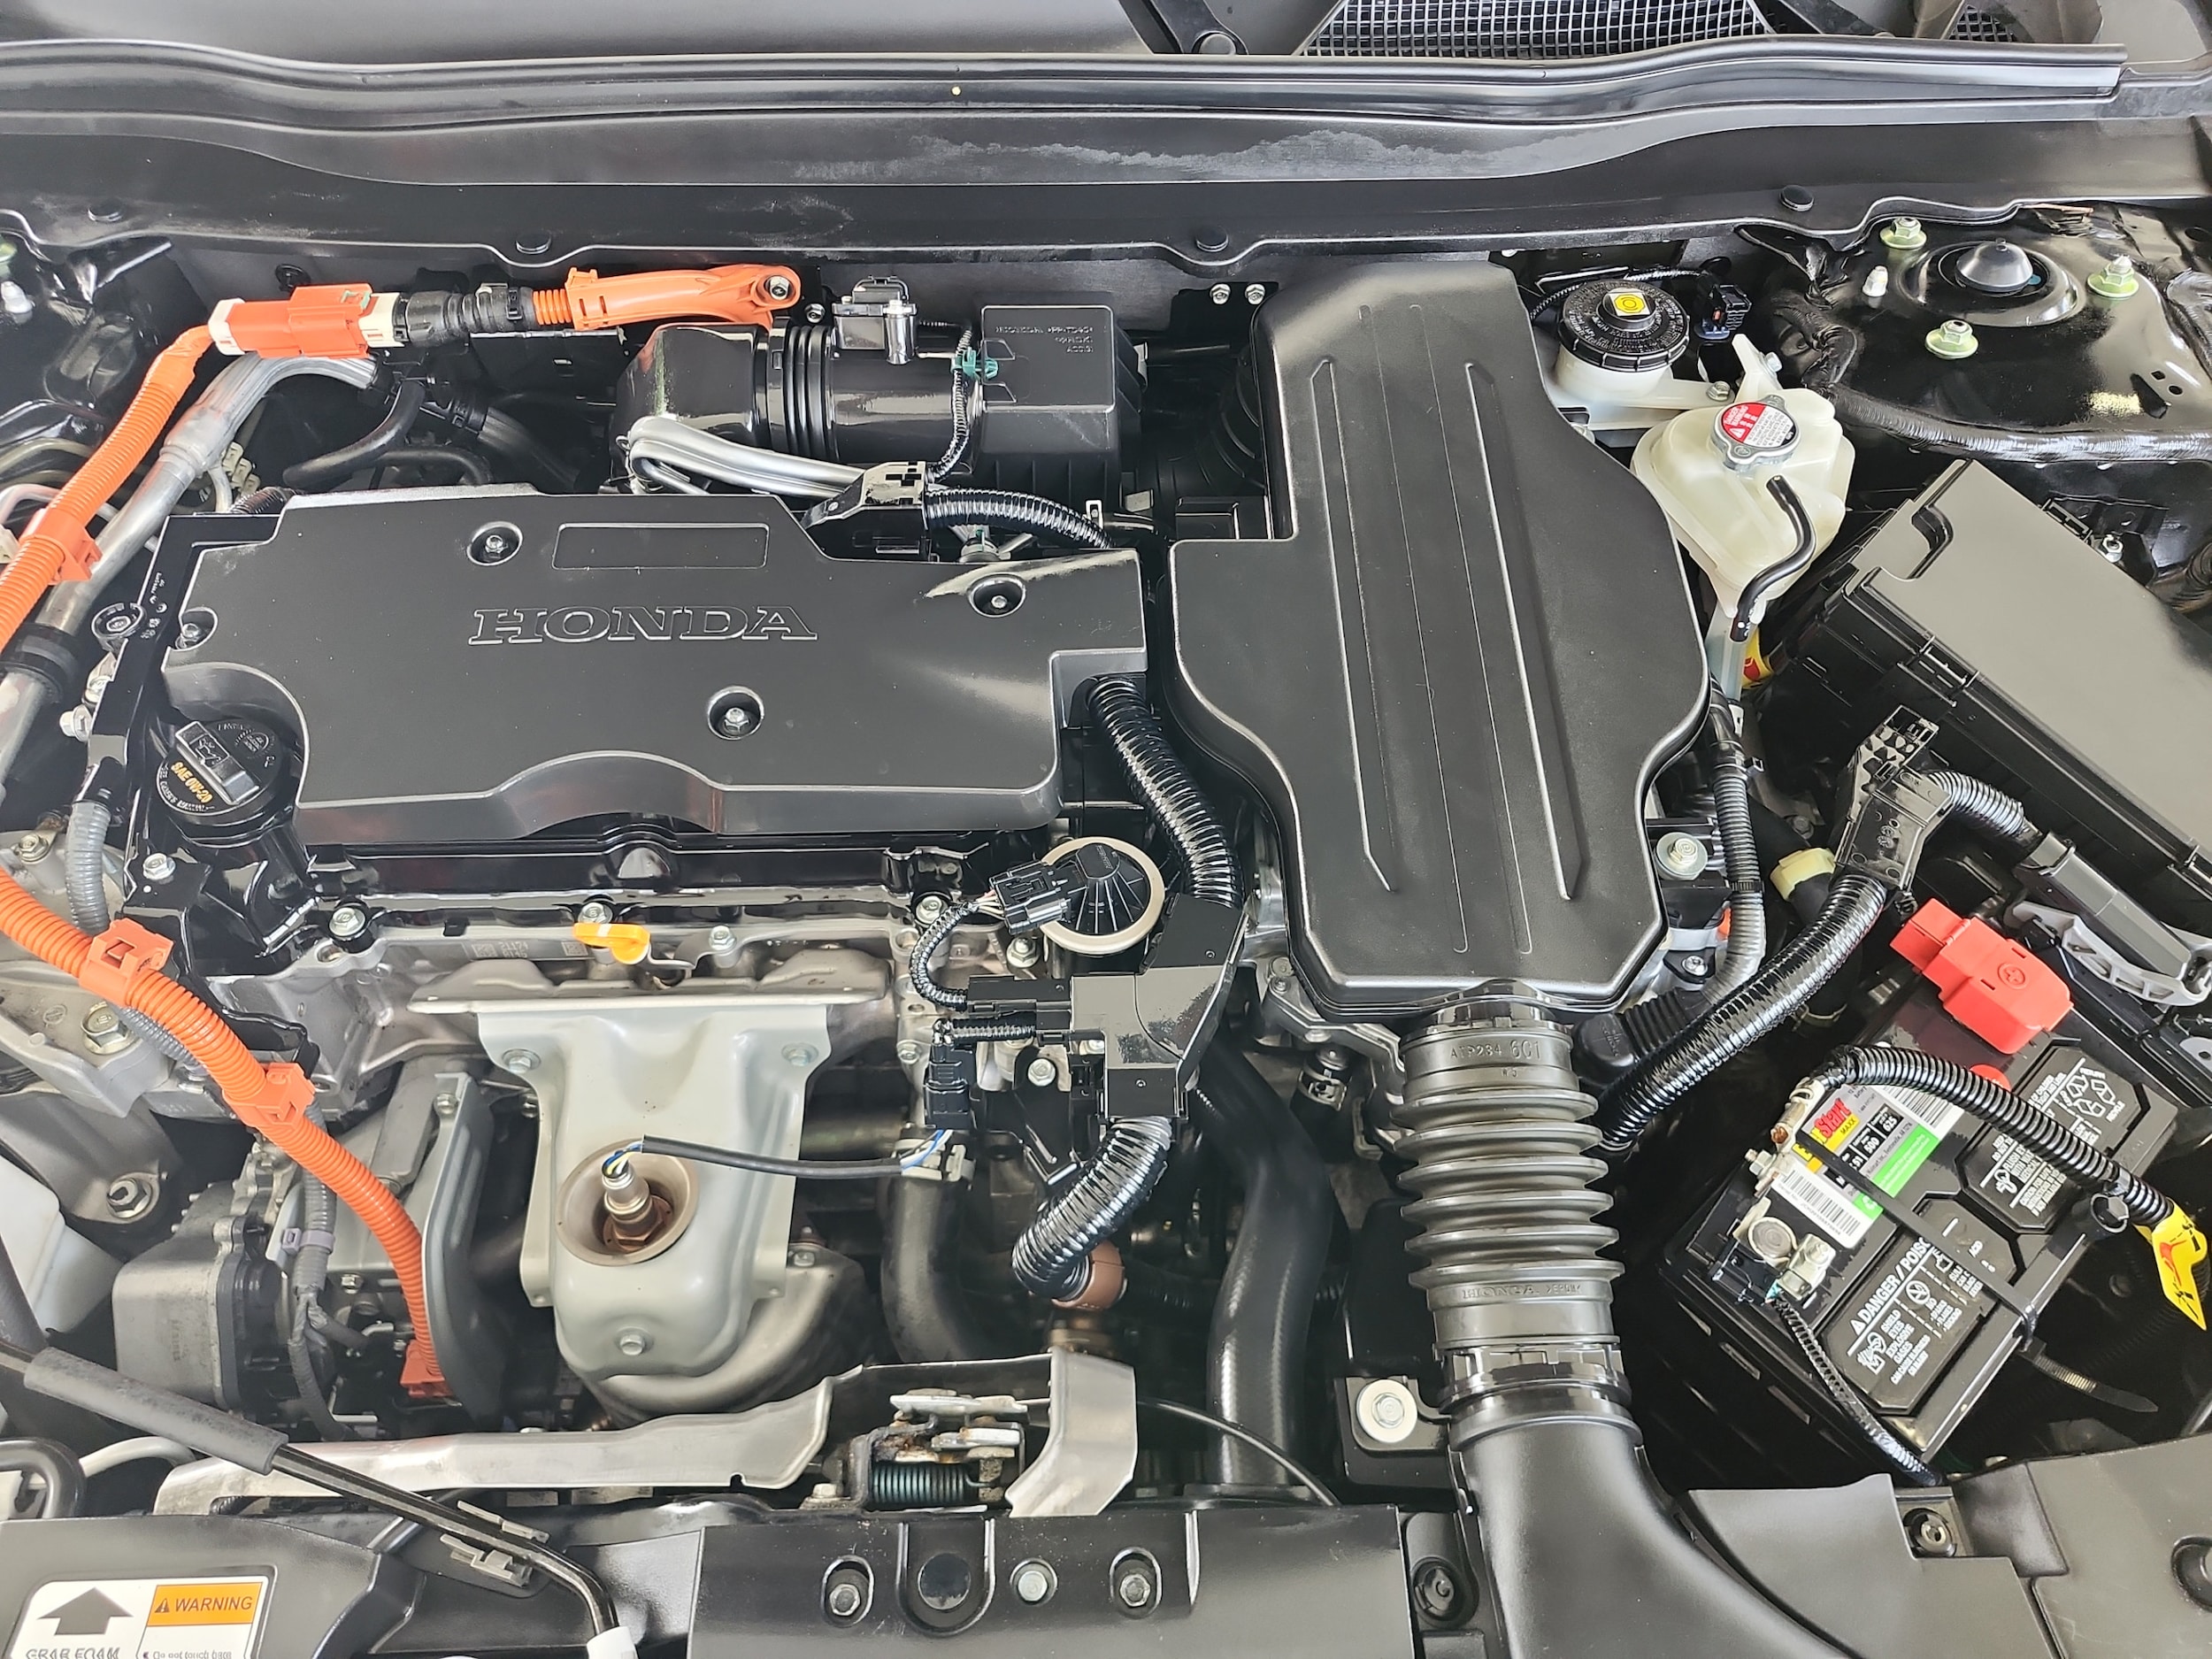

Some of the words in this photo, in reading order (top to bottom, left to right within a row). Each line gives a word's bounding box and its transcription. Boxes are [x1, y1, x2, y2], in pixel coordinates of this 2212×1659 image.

[468, 605, 818, 646] HONDA
[171, 762, 193, 781] SAE
[185, 777, 212, 803] 0W-20
[1840, 1117, 1856, 1135] MAXX
[1881, 1115, 1897, 1132] 625
[1863, 1136, 1879, 1153] 500
[2002, 1151, 2020, 1171] FLUSH
[2017, 1159, 2039, 1182] MEDICAL
[1924, 1298, 1937, 1310] NO
[1880, 1310, 1901, 1333] SHIELD
[1888, 1320, 1905, 1340] EYES
[1886, 1324, 1915, 1358] EXPLOSIVE
[1893, 1340, 1913, 1364] GASES
[175, 1596, 252, 1612] WARNING
